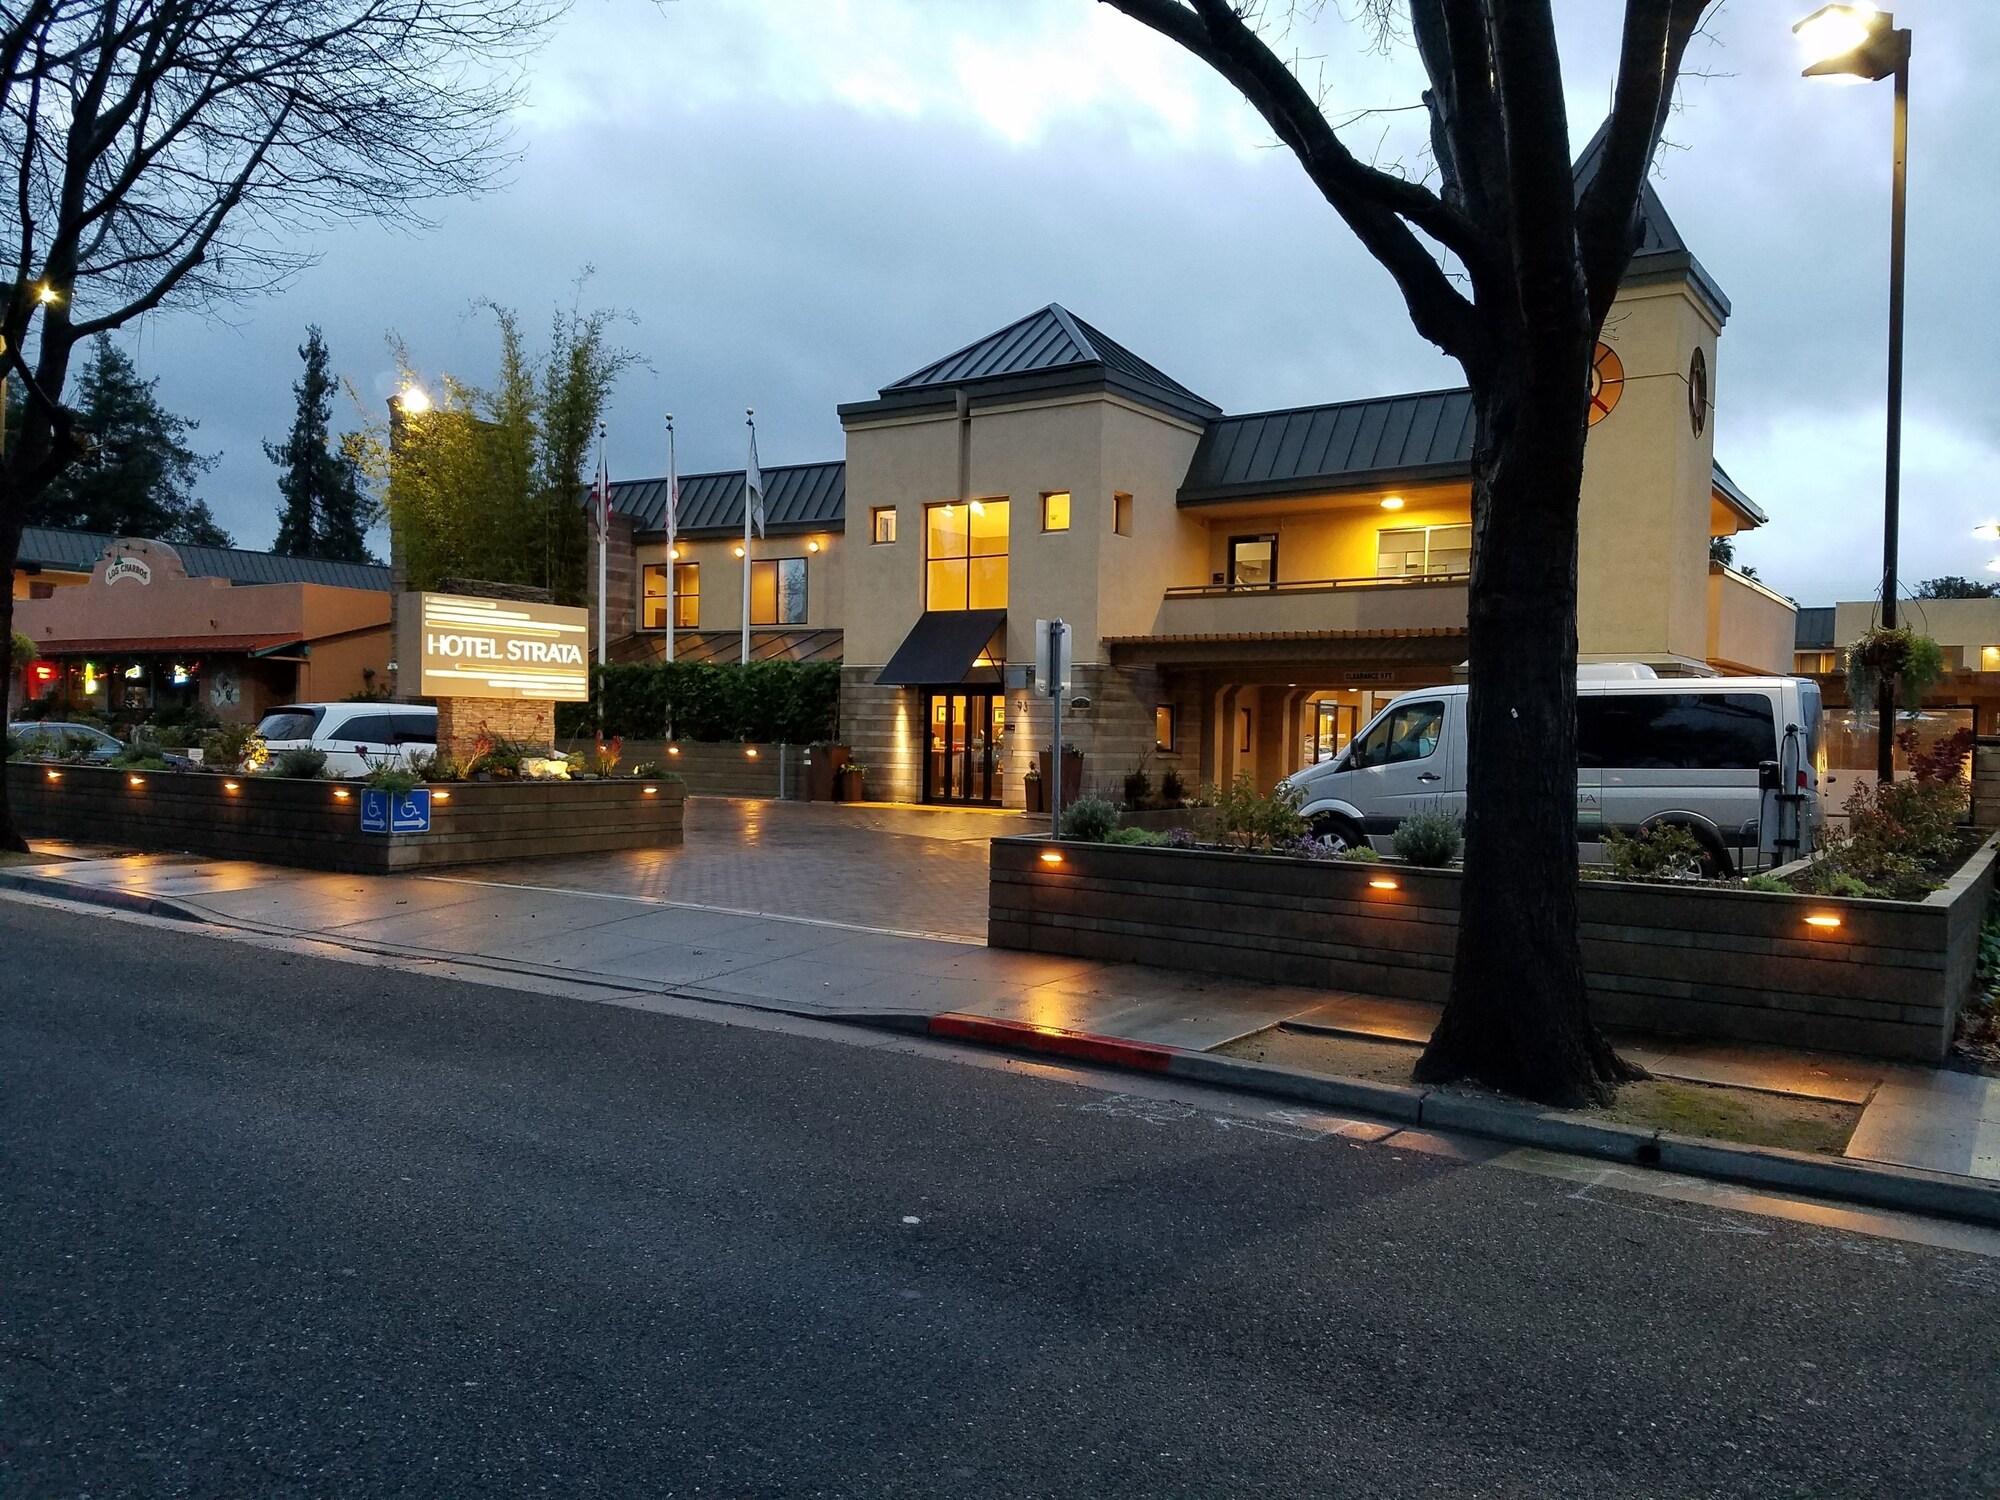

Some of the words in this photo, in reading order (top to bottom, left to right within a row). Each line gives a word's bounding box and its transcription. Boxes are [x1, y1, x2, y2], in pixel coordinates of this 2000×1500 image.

[107, 566, 119, 580] LOS
[120, 563, 148, 580] CHARROS
[427, 633, 503, 660] HOTEL
[506, 639, 583, 665] STRATA
